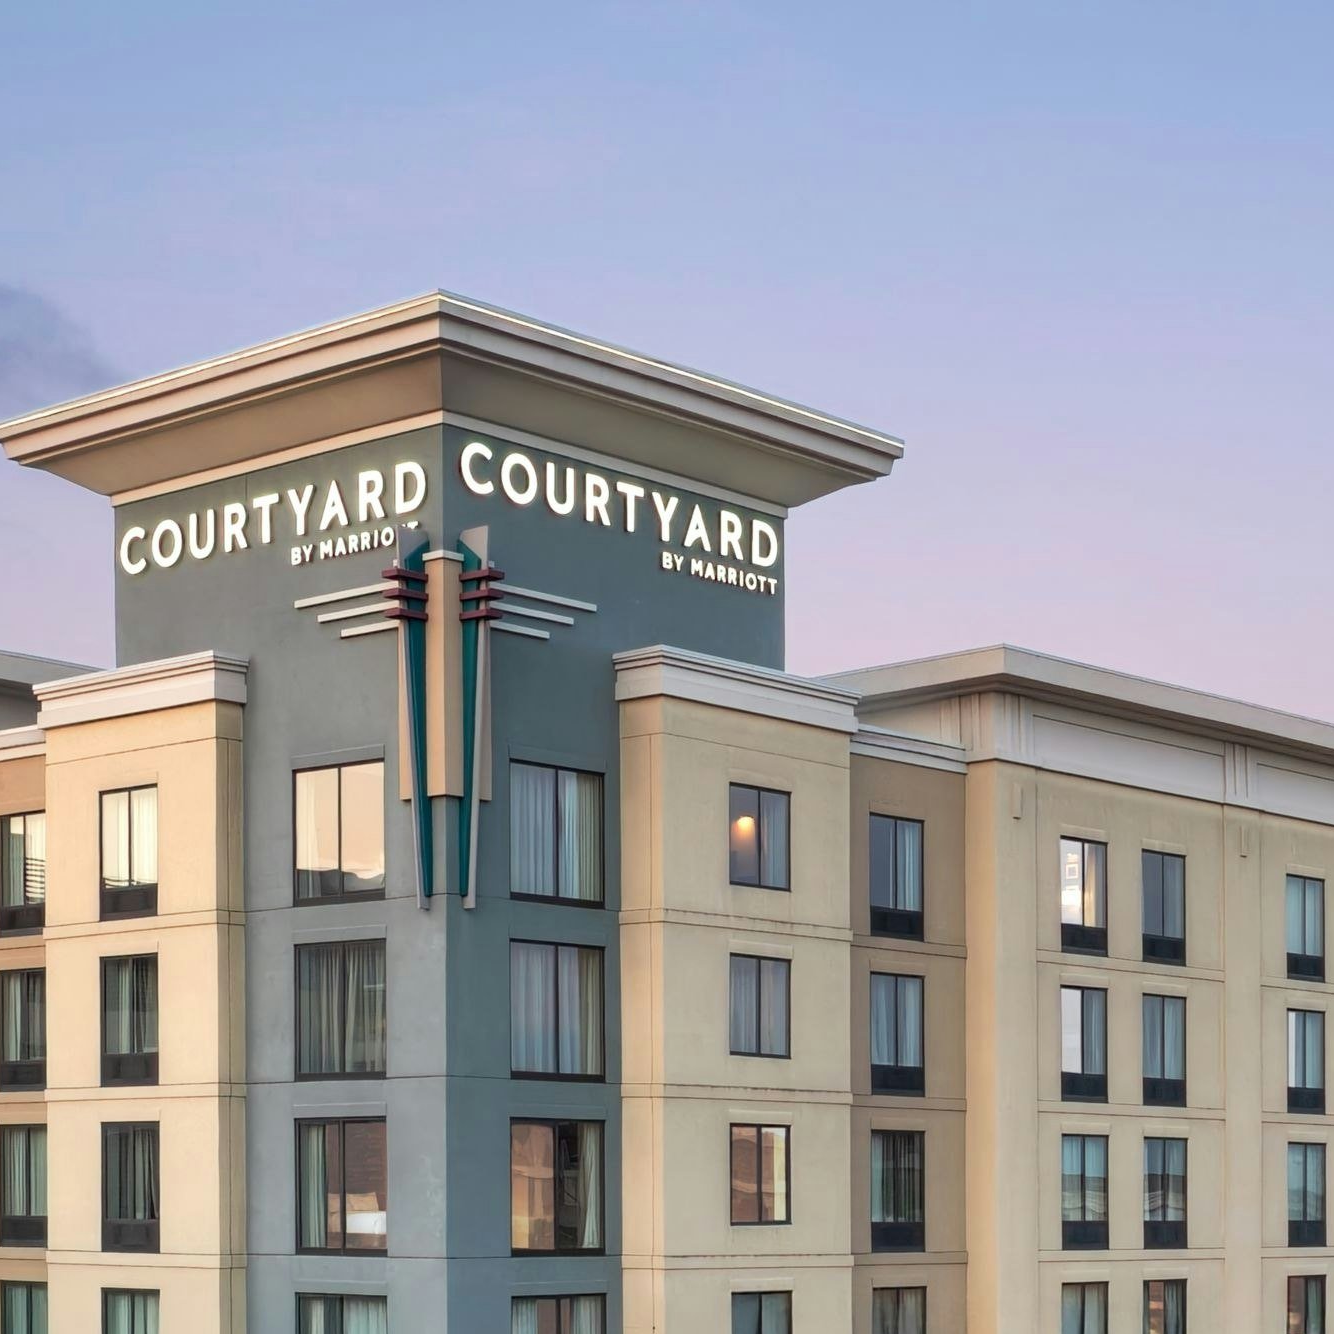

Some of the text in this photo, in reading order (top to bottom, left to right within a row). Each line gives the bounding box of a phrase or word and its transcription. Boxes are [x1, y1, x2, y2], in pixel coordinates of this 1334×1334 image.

[120, 461, 427, 575] COURTYARD
[291, 521, 419, 566] BY MARRIO
[460, 442, 779, 567] COURTYARD
[662, 551, 778, 595] BY MARRIOTT
